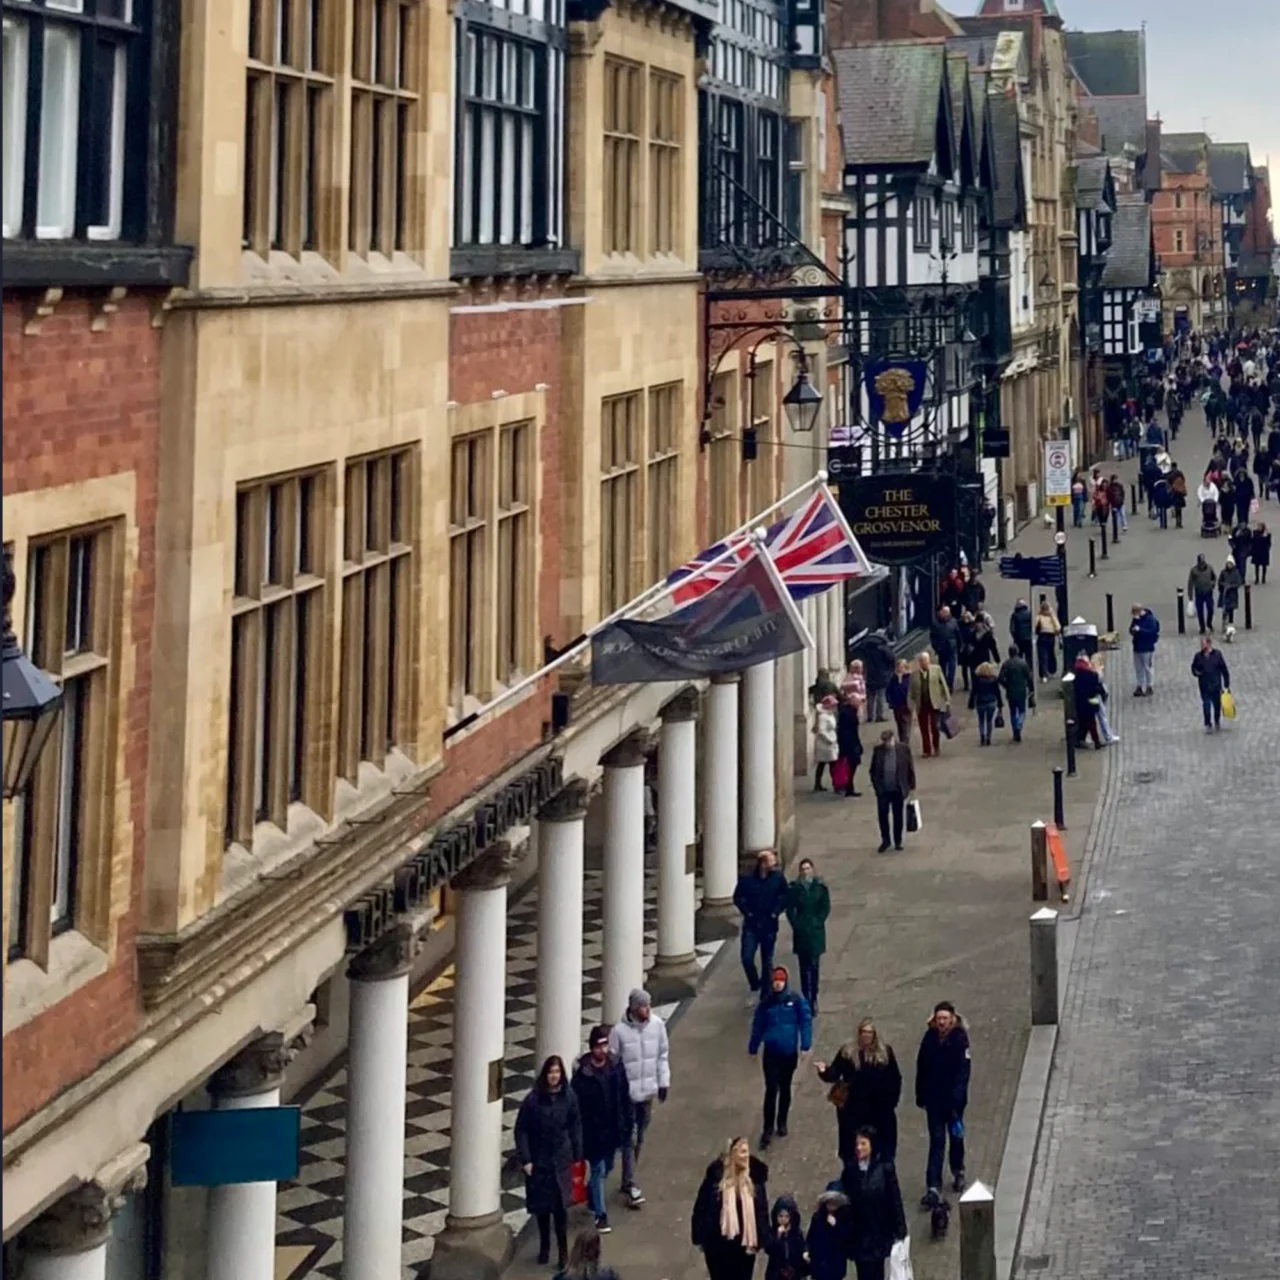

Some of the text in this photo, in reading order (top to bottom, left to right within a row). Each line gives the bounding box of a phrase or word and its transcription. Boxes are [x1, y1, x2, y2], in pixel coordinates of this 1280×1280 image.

[883, 489, 913, 502] THE
[865, 504, 930, 519] CHESTER
[853, 519, 941, 535] GROSVENOR
